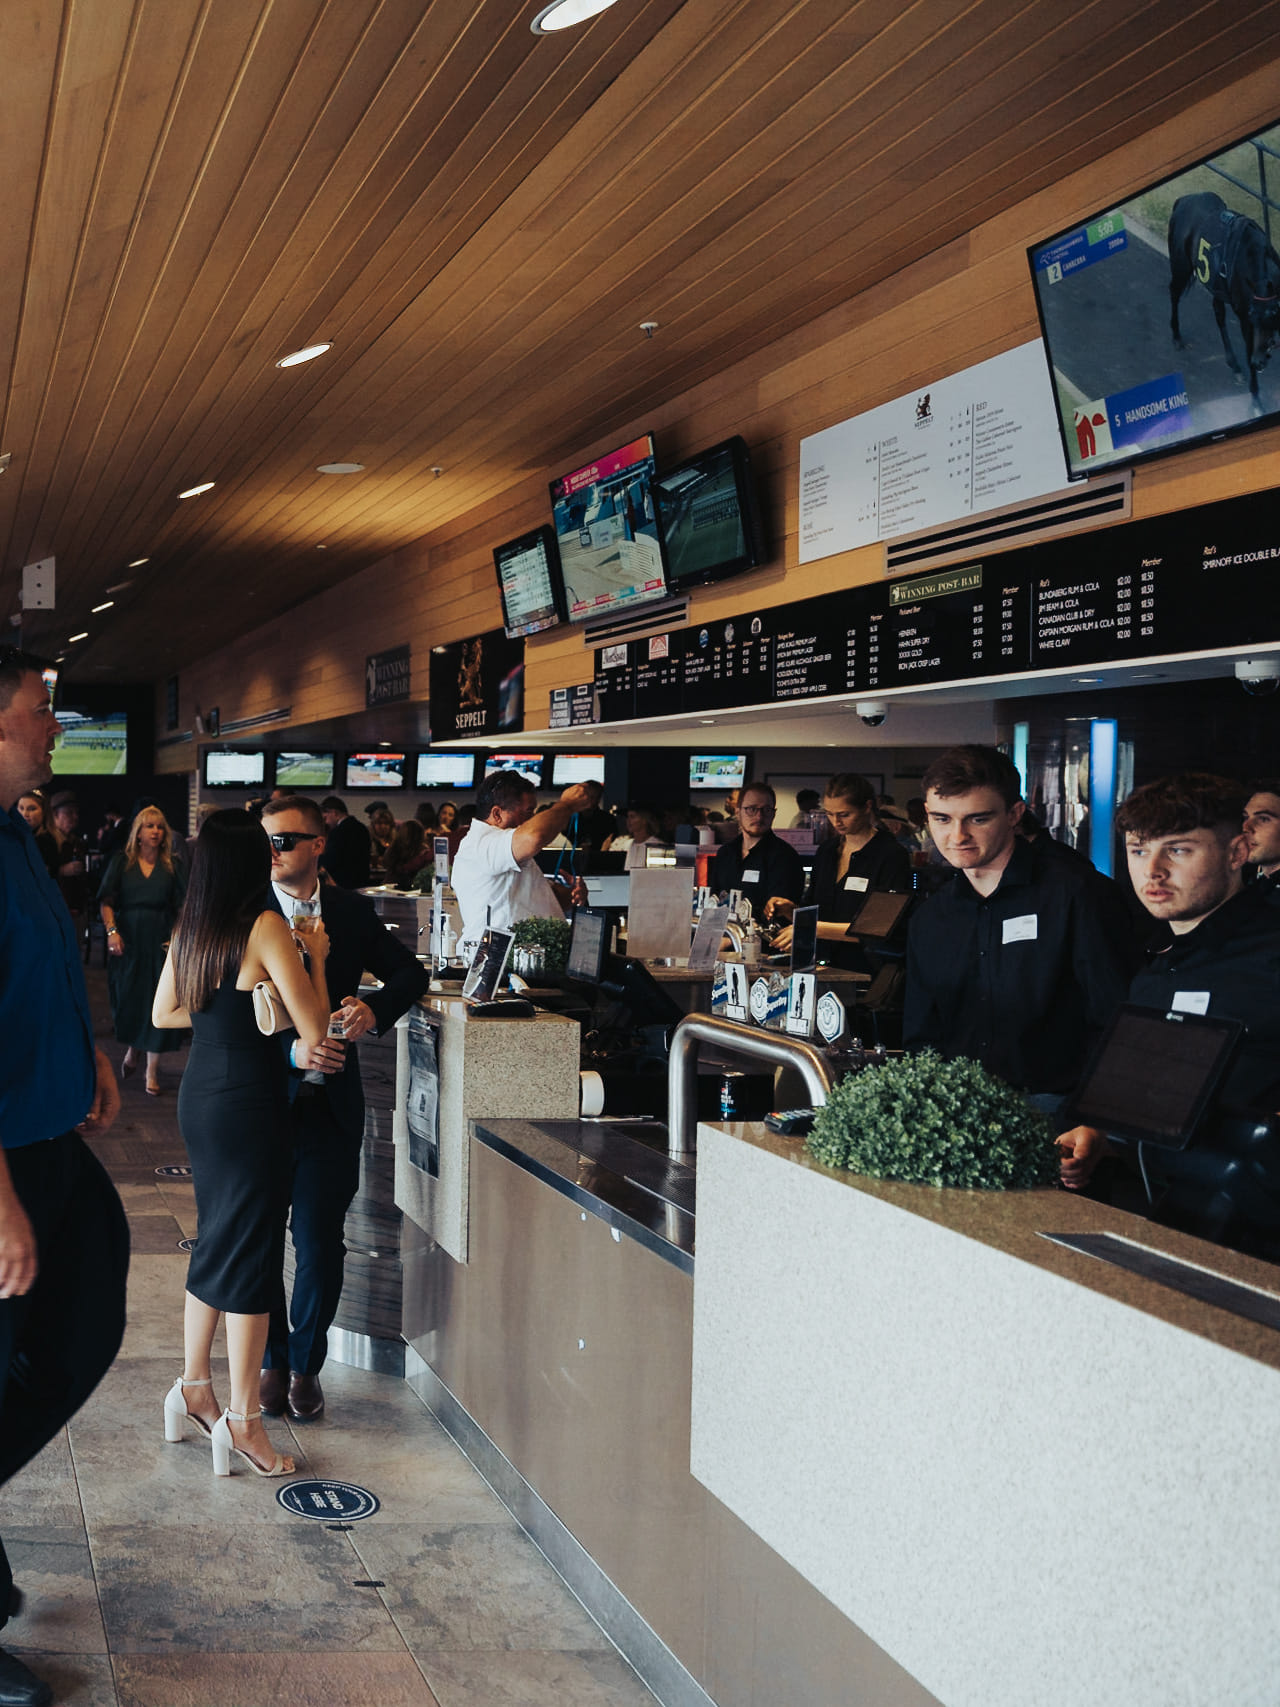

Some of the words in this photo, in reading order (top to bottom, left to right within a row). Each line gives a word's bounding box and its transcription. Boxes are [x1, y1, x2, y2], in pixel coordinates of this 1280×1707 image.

[1197, 237, 1211, 283] 5
[1052, 266, 1058, 279] 2
[1115, 414, 1120, 427] 5
[1125, 398, 1168, 424] HANDSOME
[1168, 392, 1189, 409] KING
[1234, 554, 1242, 564] ICE
[1244, 549, 1269, 562] DOUBLE
[900, 585, 936, 599] WINNING
[1085, 609, 1095, 617] DRY
[1056, 639, 1070, 647] CLAW
[456, 710, 487, 729] SEPPELT
[309, 1492, 328, 1509] HERE
[324, 1490, 344, 1510] STAND
